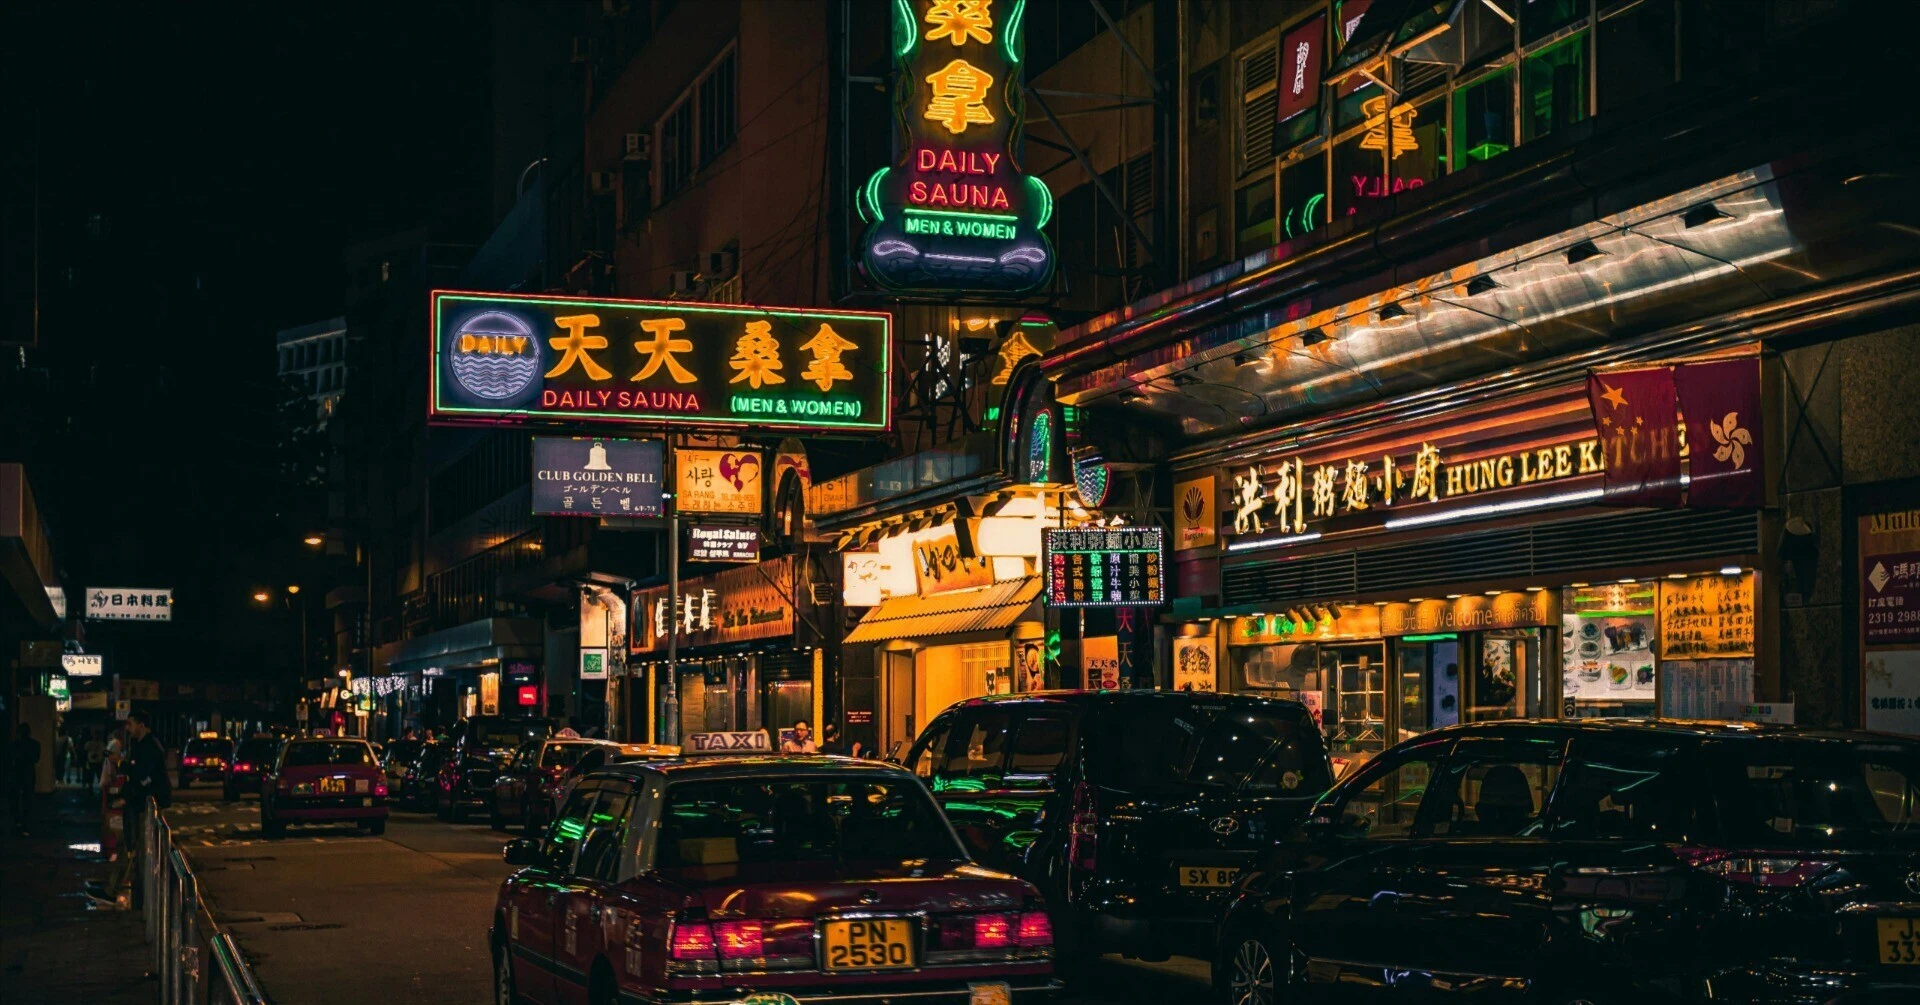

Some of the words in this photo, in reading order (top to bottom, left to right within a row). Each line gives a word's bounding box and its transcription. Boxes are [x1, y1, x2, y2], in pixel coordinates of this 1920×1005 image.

[917, 149, 1000, 174] DAILY
[909, 181, 1009, 209] SAUNA
[905, 217, 940, 234] MEN
[943, 219, 954, 234] &
[956, 221, 1016, 239] WOMEN
[461, 334, 527, 355] DAILY
[544, 313, 859, 392] 天天桑拿
[543, 390, 610, 408] DAILY
[617, 392, 699, 411] SAUNA
[731, 395, 773, 414] (MEN
[776, 398, 787, 414] &
[791, 399, 861, 417] WOMEN)
[537, 471, 571, 482] CLUB
[573, 472, 623, 483] GOLDEN
[626, 474, 657, 484] BELL
[686, 467, 714, 488] 사랑
[1446, 455, 1512, 496] HUNG
[1519, 444, 1571, 483] LEE
[563, 484, 631, 494] ゴールデンベル
[692, 528, 722, 540] Royal
[723, 530, 756, 540] Salute
[111, 594, 167, 607] 日本料理
[1433, 606, 1491, 629] Welcome
[1868, 611, 1894, 624] 2319
[691, 733, 765, 750] TAXI
[1188, 869, 1214, 885] SX
[849, 922, 885, 945] PN
[831, 942, 906, 967] 2530
